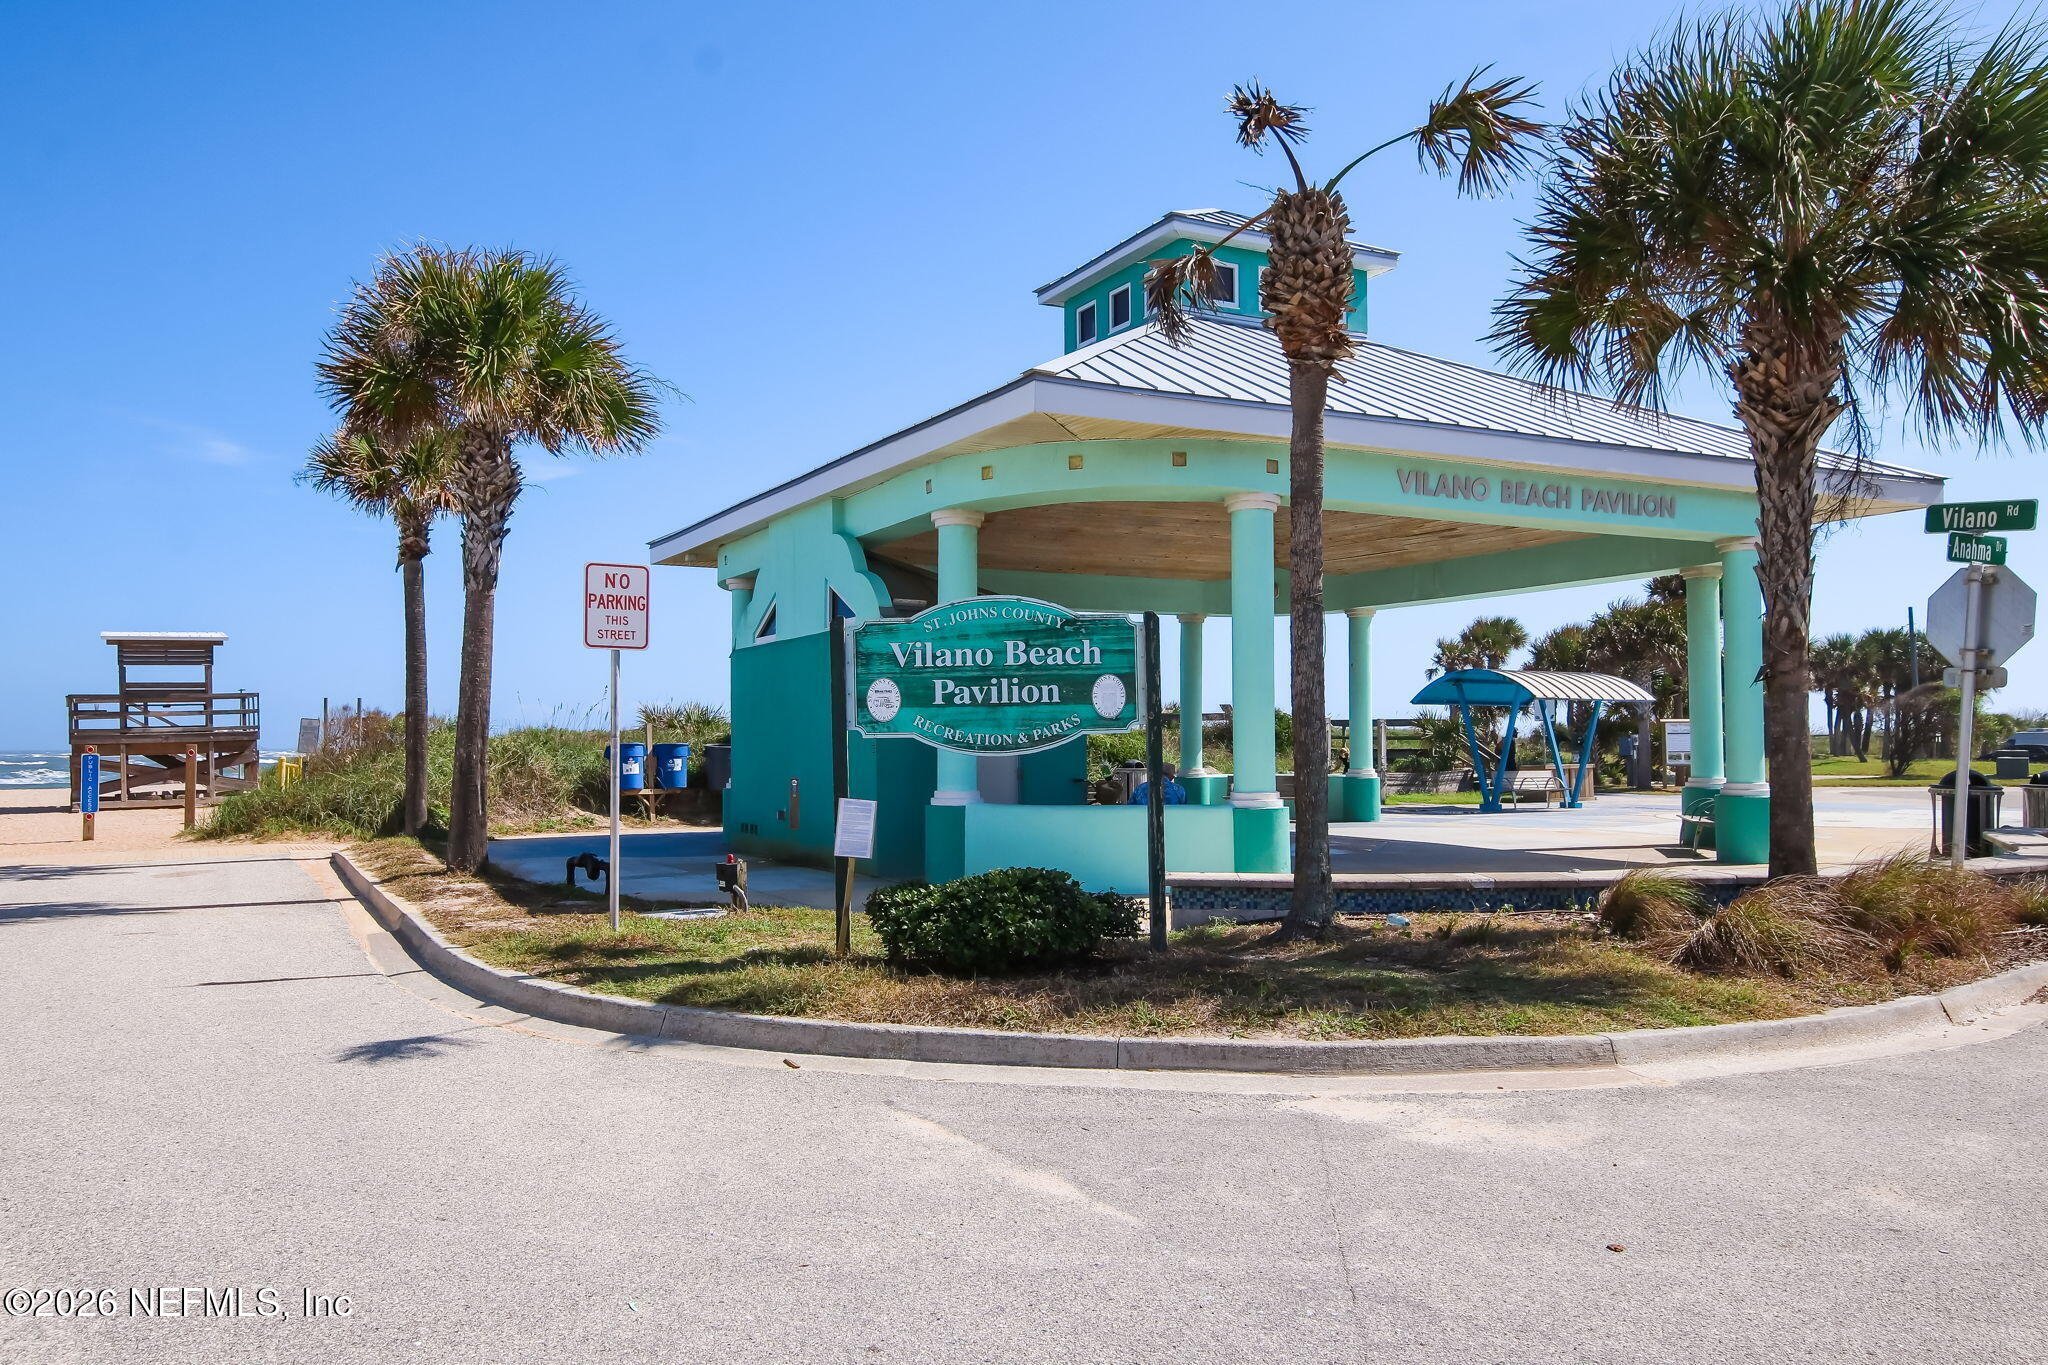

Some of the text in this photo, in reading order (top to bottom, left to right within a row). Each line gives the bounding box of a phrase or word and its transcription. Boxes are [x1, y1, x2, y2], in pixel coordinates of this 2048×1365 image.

[1396, 468, 1677, 519] VILANO BEACH PAVILION
[1942, 504, 2020, 529] Vilano Rd
[1952, 536, 1992, 562] Anahma
[604, 572, 631, 590] NO
[587, 593, 647, 612] PARKING
[605, 615, 629, 626] THIS
[949, 606, 998, 626] JOHNS
[1001, 606, 1066, 629] COUNTY
[597, 629, 637, 641] STREET
[888, 639, 1103, 668] Vilano Beach
[931, 677, 1061, 706] Pavilion
[912, 713, 1082, 746] RECREATION & PARKS
